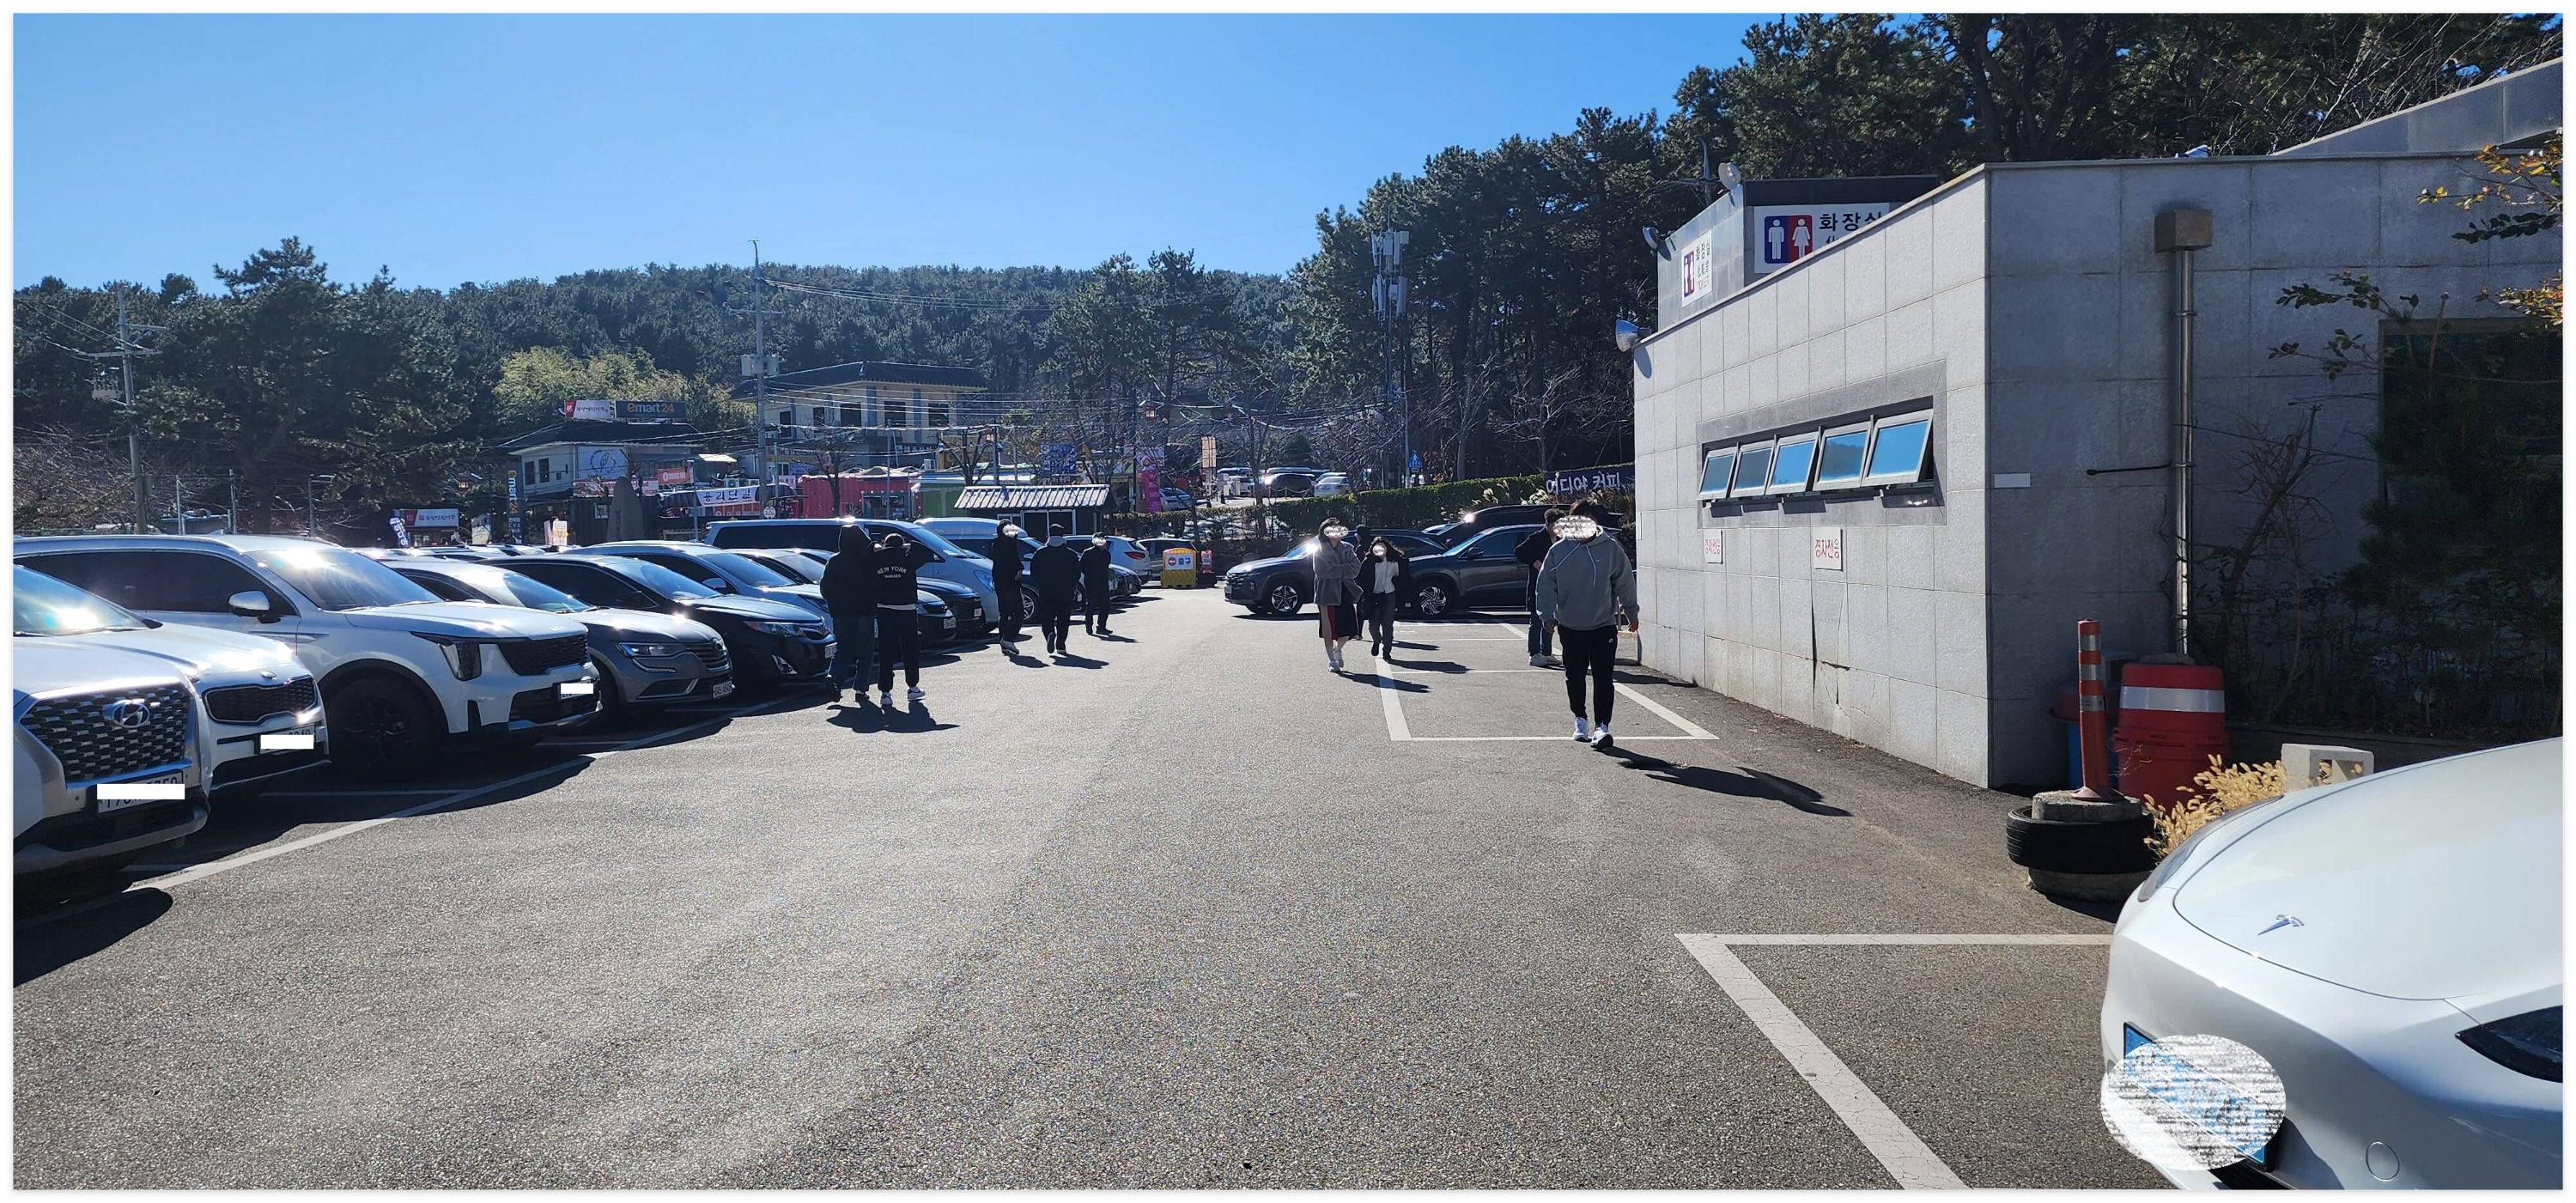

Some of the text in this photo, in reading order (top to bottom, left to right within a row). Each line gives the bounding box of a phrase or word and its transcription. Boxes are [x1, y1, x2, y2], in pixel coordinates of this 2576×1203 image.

[628, 403, 674, 413] emart24
[1546, 475, 1589, 495] 이디야
[1592, 471, 1620, 491] 커피
[507, 470, 519, 513] emart24
[702, 489, 753, 502] 용리단길
[877, 566, 890, 575] NEW
